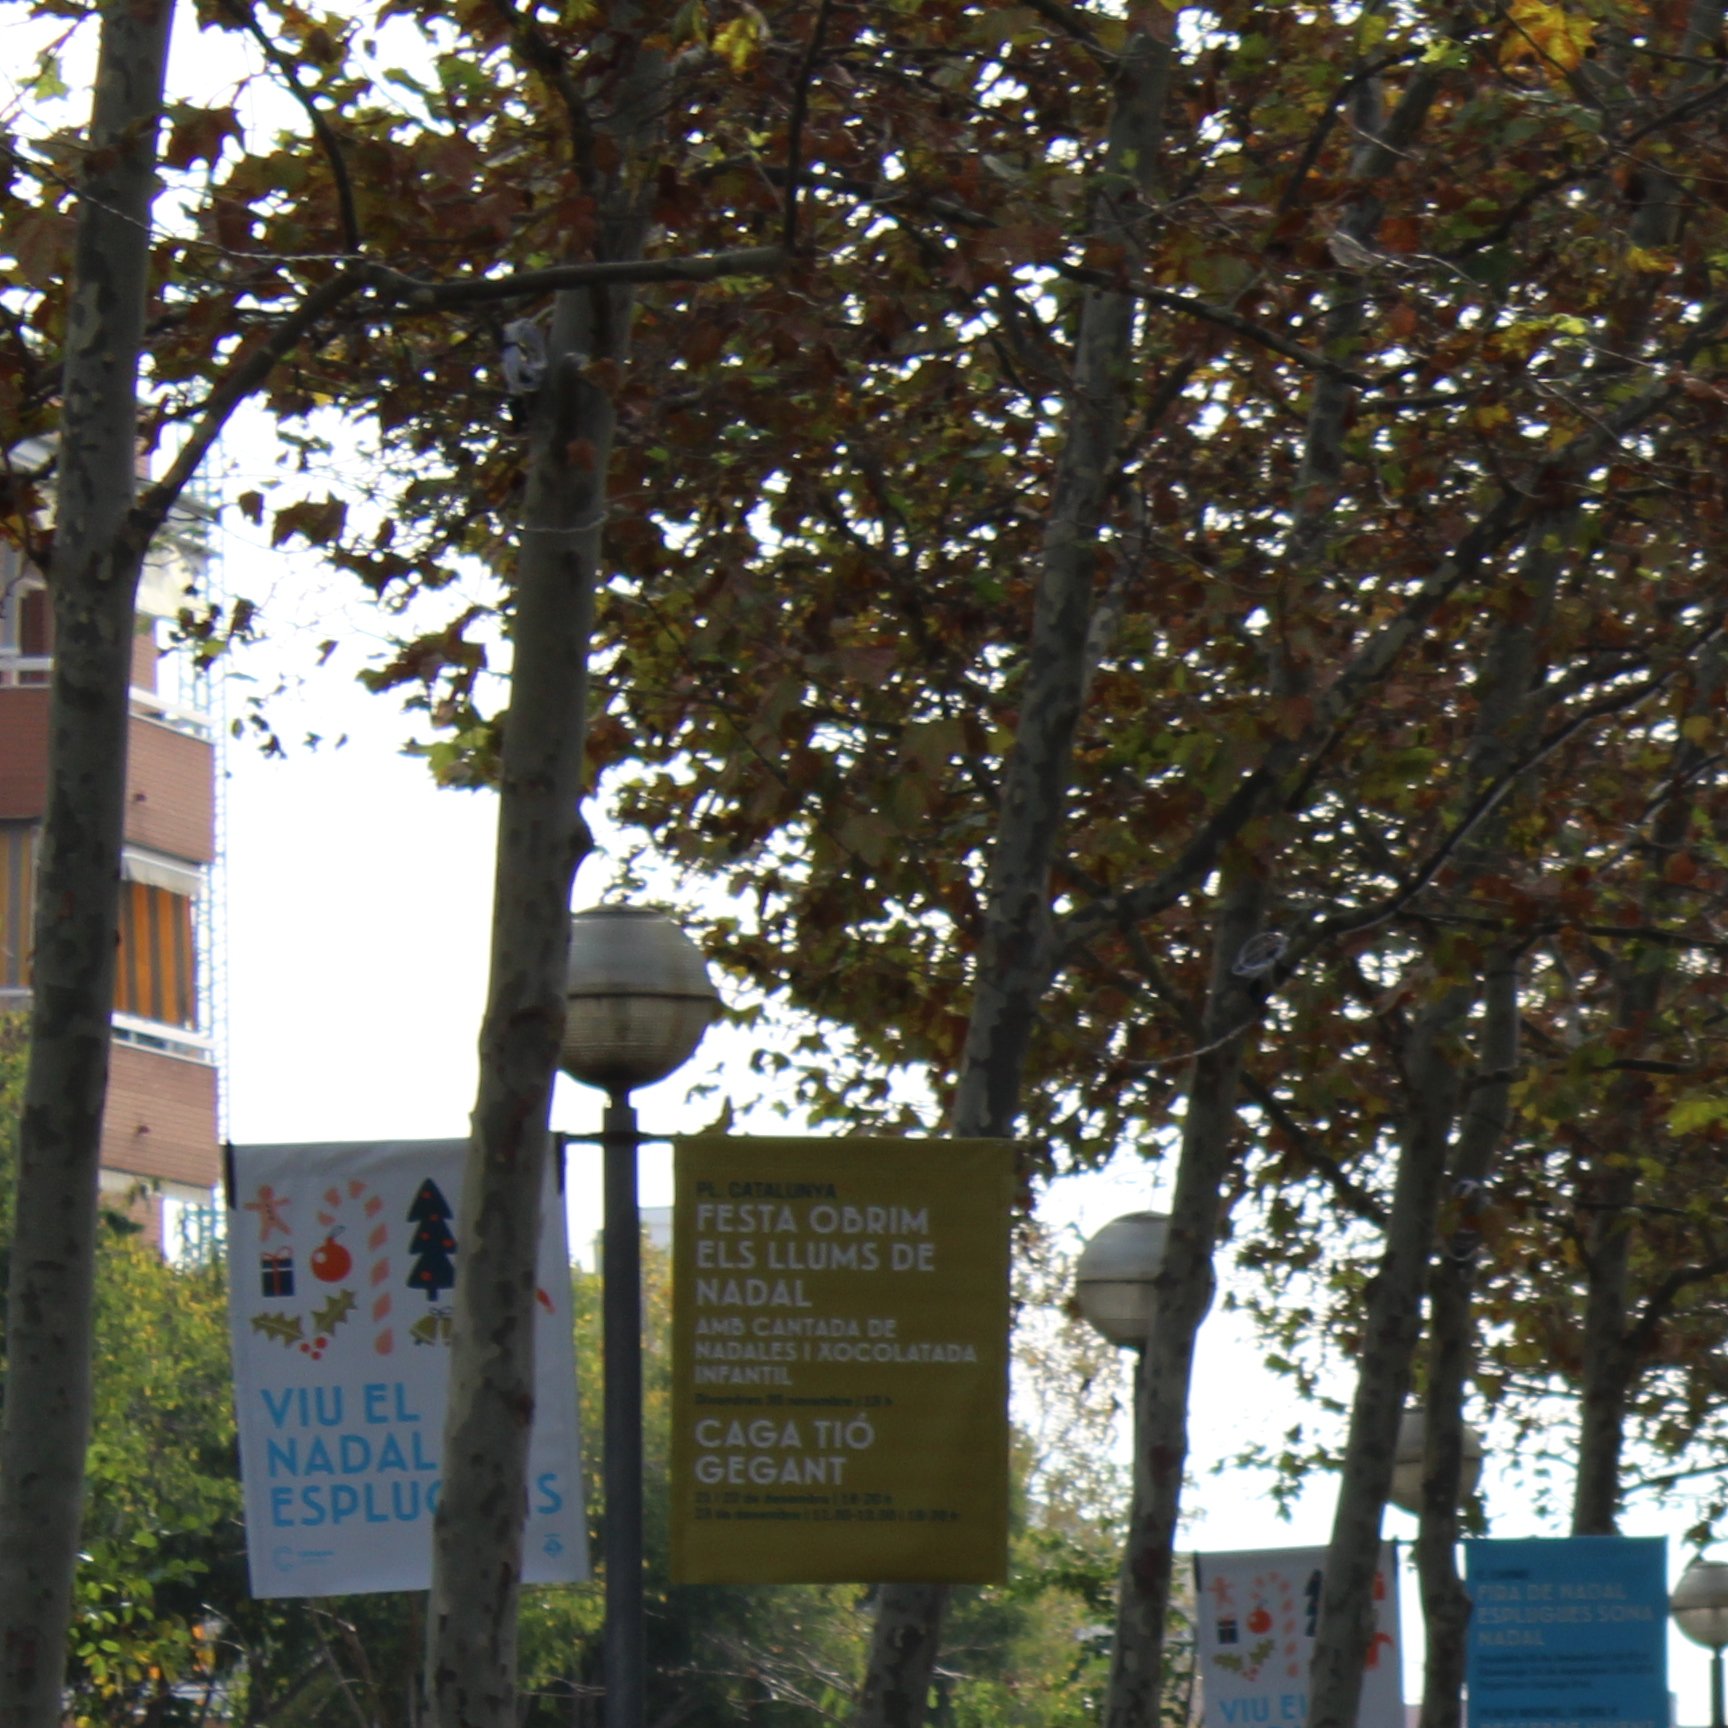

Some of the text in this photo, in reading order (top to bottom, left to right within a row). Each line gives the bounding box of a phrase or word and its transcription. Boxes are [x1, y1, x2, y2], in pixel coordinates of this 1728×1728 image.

[696, 1203, 930, 1236] FESTA OBRIM
[696, 1240, 936, 1272] ELS LLUMS DE
[696, 1278, 813, 1308] NADAL
[695, 1317, 896, 1339] AMB CANTADA DE
[695, 1341, 797, 1361] NADALES
[817, 1342, 978, 1364] XOCOLATADA
[694, 1365, 793, 1386] INFANTIL
[261, 1382, 421, 1429] VIU EL
[694, 1412, 876, 1450] CAGA TIÓ
[267, 1431, 438, 1478] NADAL
[694, 1454, 847, 1486] GEGANT
[1477, 1629, 1545, 1646] NADAL
[1218, 1695, 1269, 1722] VIU
